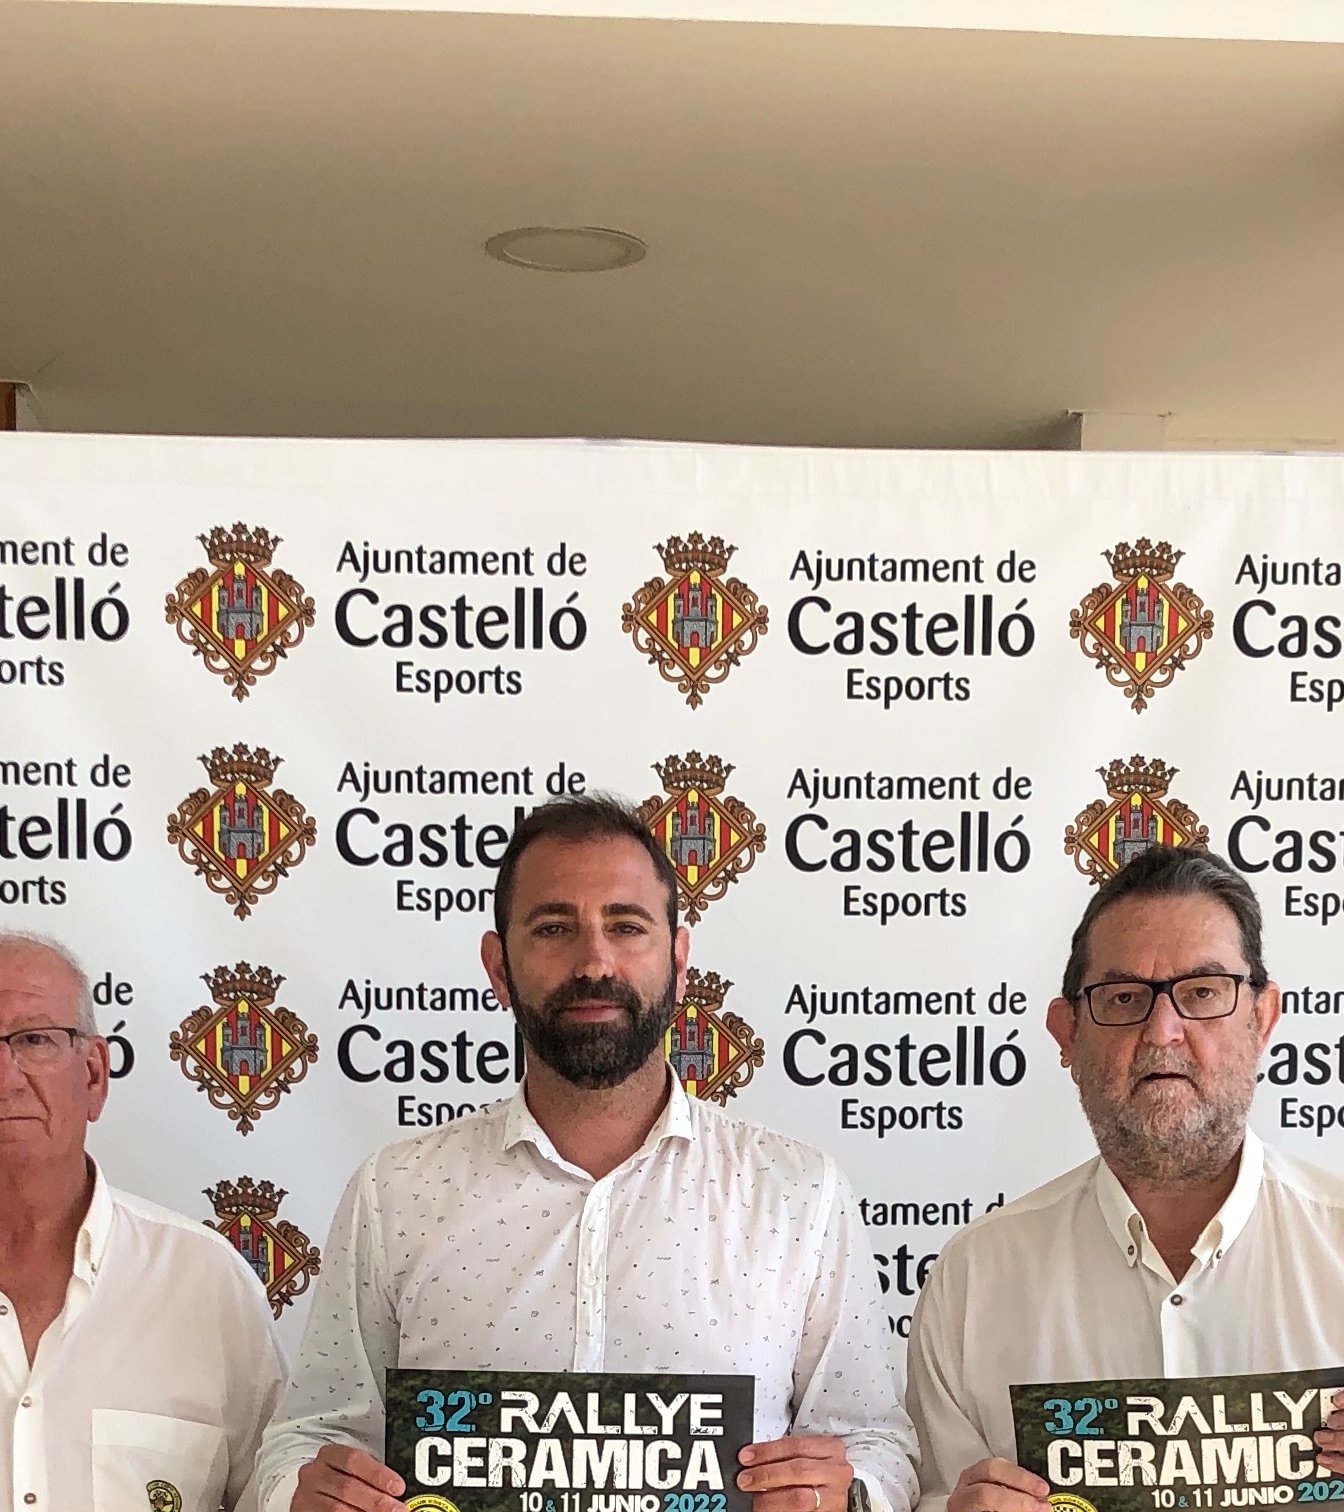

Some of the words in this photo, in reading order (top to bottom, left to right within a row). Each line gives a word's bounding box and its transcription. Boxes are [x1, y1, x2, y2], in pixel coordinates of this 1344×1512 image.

[88, 532, 129, 567] de
[336, 541, 535, 583] Ajuntament
[546, 542, 587, 576] de
[789, 550, 984, 591] Ajuntament
[996, 550, 1036, 583] de
[334, 587, 587, 651] Castelló
[787, 594, 1035, 658] Castelló
[396, 661, 522, 703] Esports
[846, 668, 970, 710] Esports
[499, 1390, 724, 1436] RALLYE
[414, 1436, 724, 1491] CERAMICA
[1151, 1489, 1176, 1509] 10
[1194, 1489, 1214, 1508] 11
[1219, 1487, 1294, 1508] JUNIO
